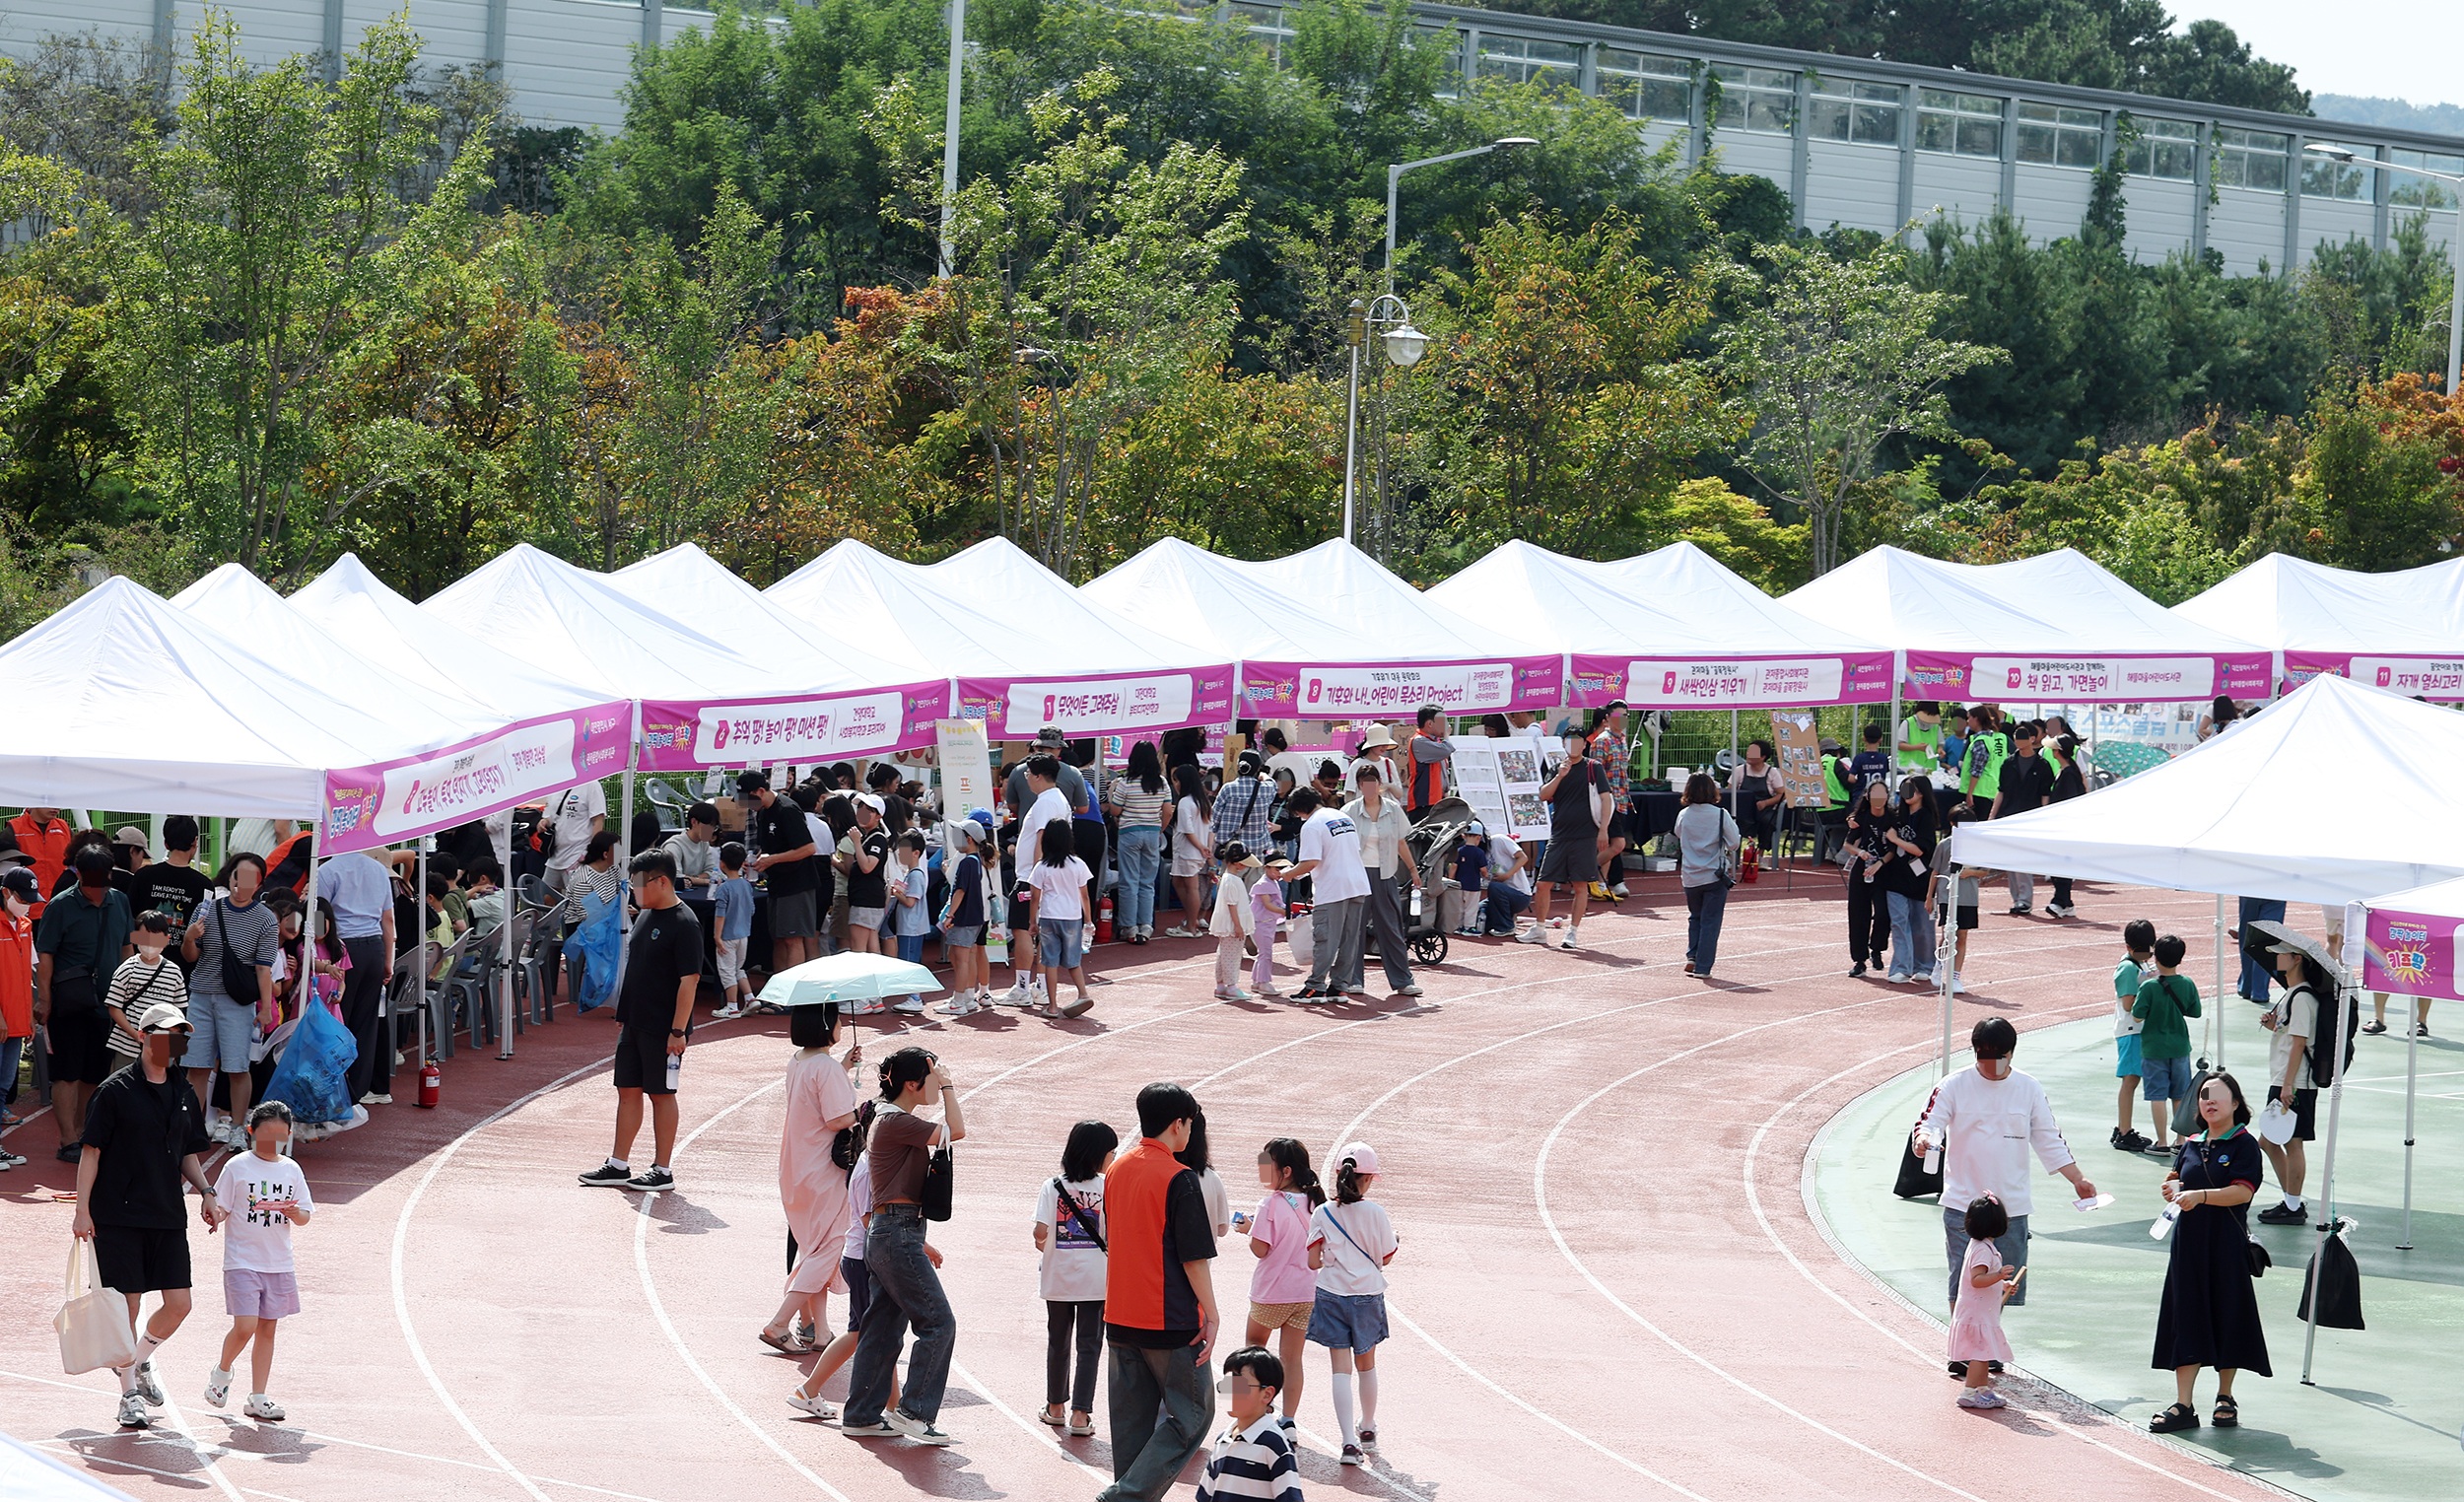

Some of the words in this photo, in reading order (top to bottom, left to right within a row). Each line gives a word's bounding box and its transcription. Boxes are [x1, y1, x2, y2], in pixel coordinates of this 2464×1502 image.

[1765, 668, 1810, 680] 관저종합사회복지관
[2010, 672, 2019, 683] 10
[2379, 671, 2389, 682] 11
[1667, 677, 1674, 688] 9
[1678, 678, 1718, 697] 새싹인삼
[1720, 678, 1747, 697] 키우기
[2026, 674, 2038, 692] 책
[2041, 674, 2064, 693] 읽고,
[2068, 675, 2108, 692] 가면놀이
[2396, 674, 2420, 688] 자개
[2422, 673, 2463, 691] 열쇠고리
[1312, 685, 1319, 697] 8
[1327, 686, 1353, 707] 기후와
[1371, 686, 1399, 706] 어린이
[1401, 685, 1426, 706] 목소리
[1426, 685, 1464, 706] Project
[1059, 695, 1089, 717] 무엇이든
[719, 728, 726, 741] 6
[733, 719, 751, 744] 추억
[765, 718, 785, 743] 놀이
[798, 716, 816, 740] 미션
[2404, 928, 2427, 941] 놀이터
